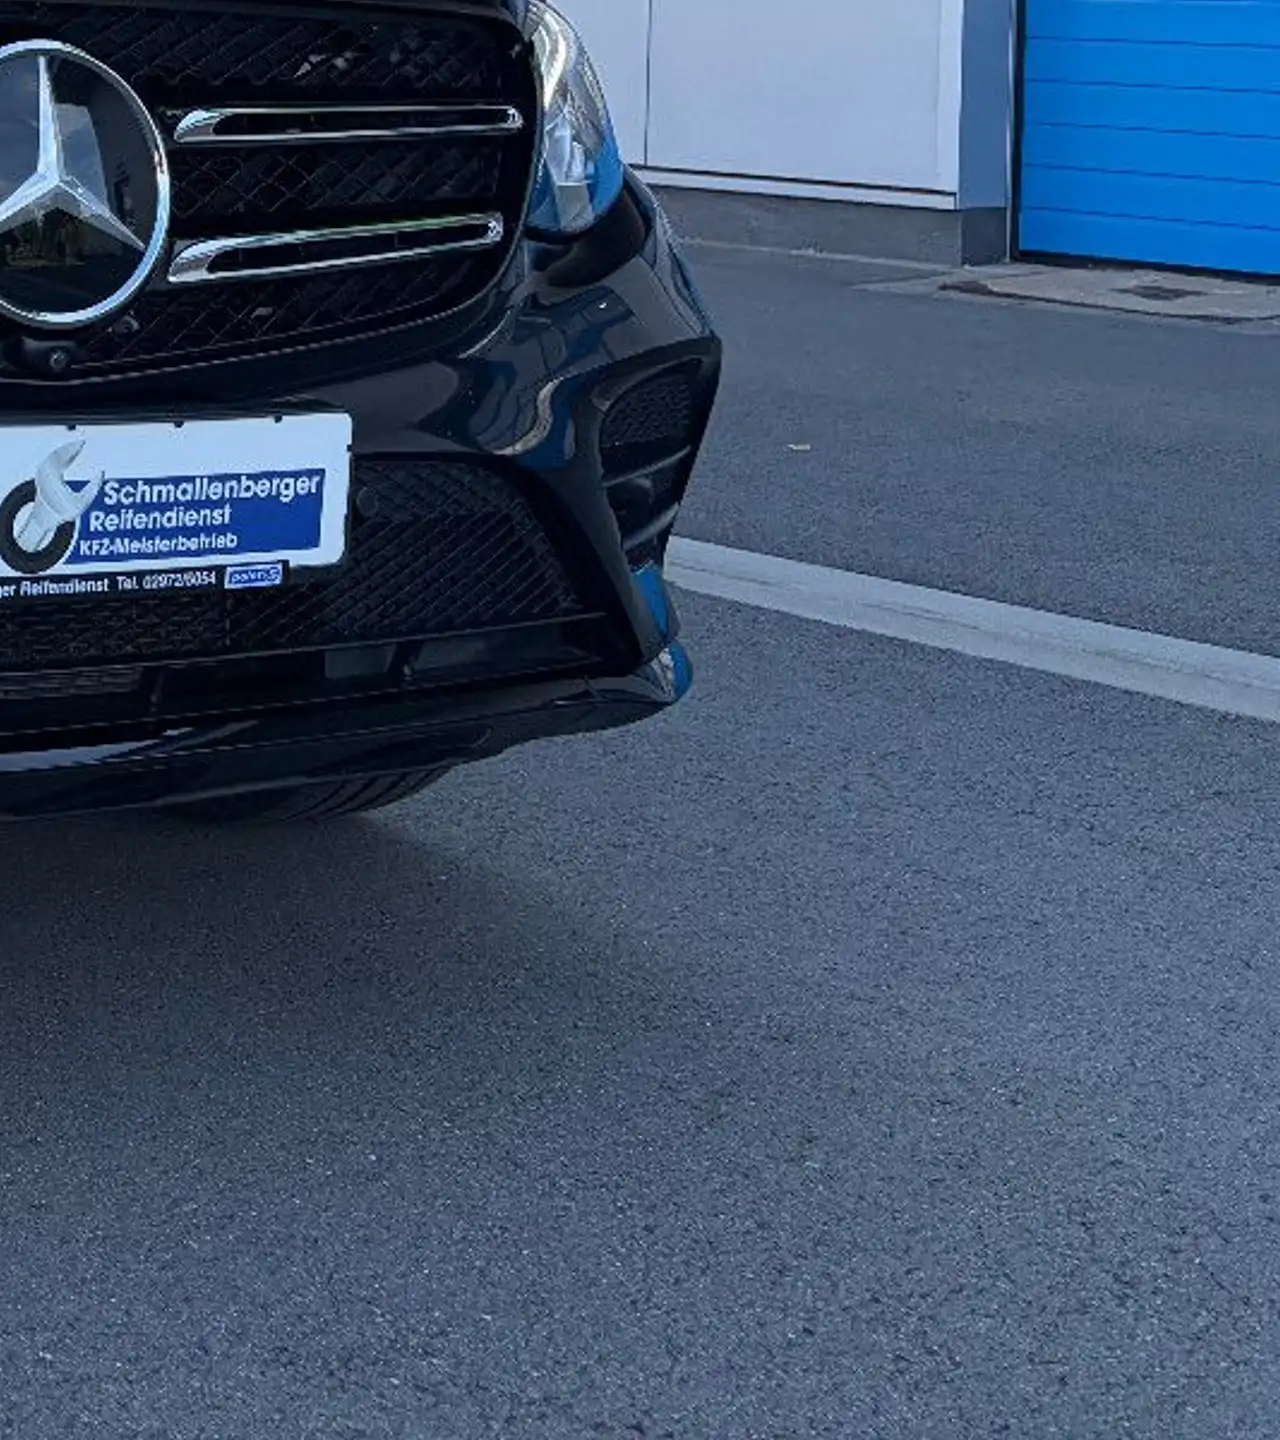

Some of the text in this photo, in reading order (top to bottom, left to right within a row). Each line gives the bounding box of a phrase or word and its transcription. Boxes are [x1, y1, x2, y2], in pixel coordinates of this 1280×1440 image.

[103, 475, 320, 505] Schmallenberger
[90, 503, 232, 532] Reifendienst
[79, 532, 237, 556] KFZ-Meisterbetrieb
